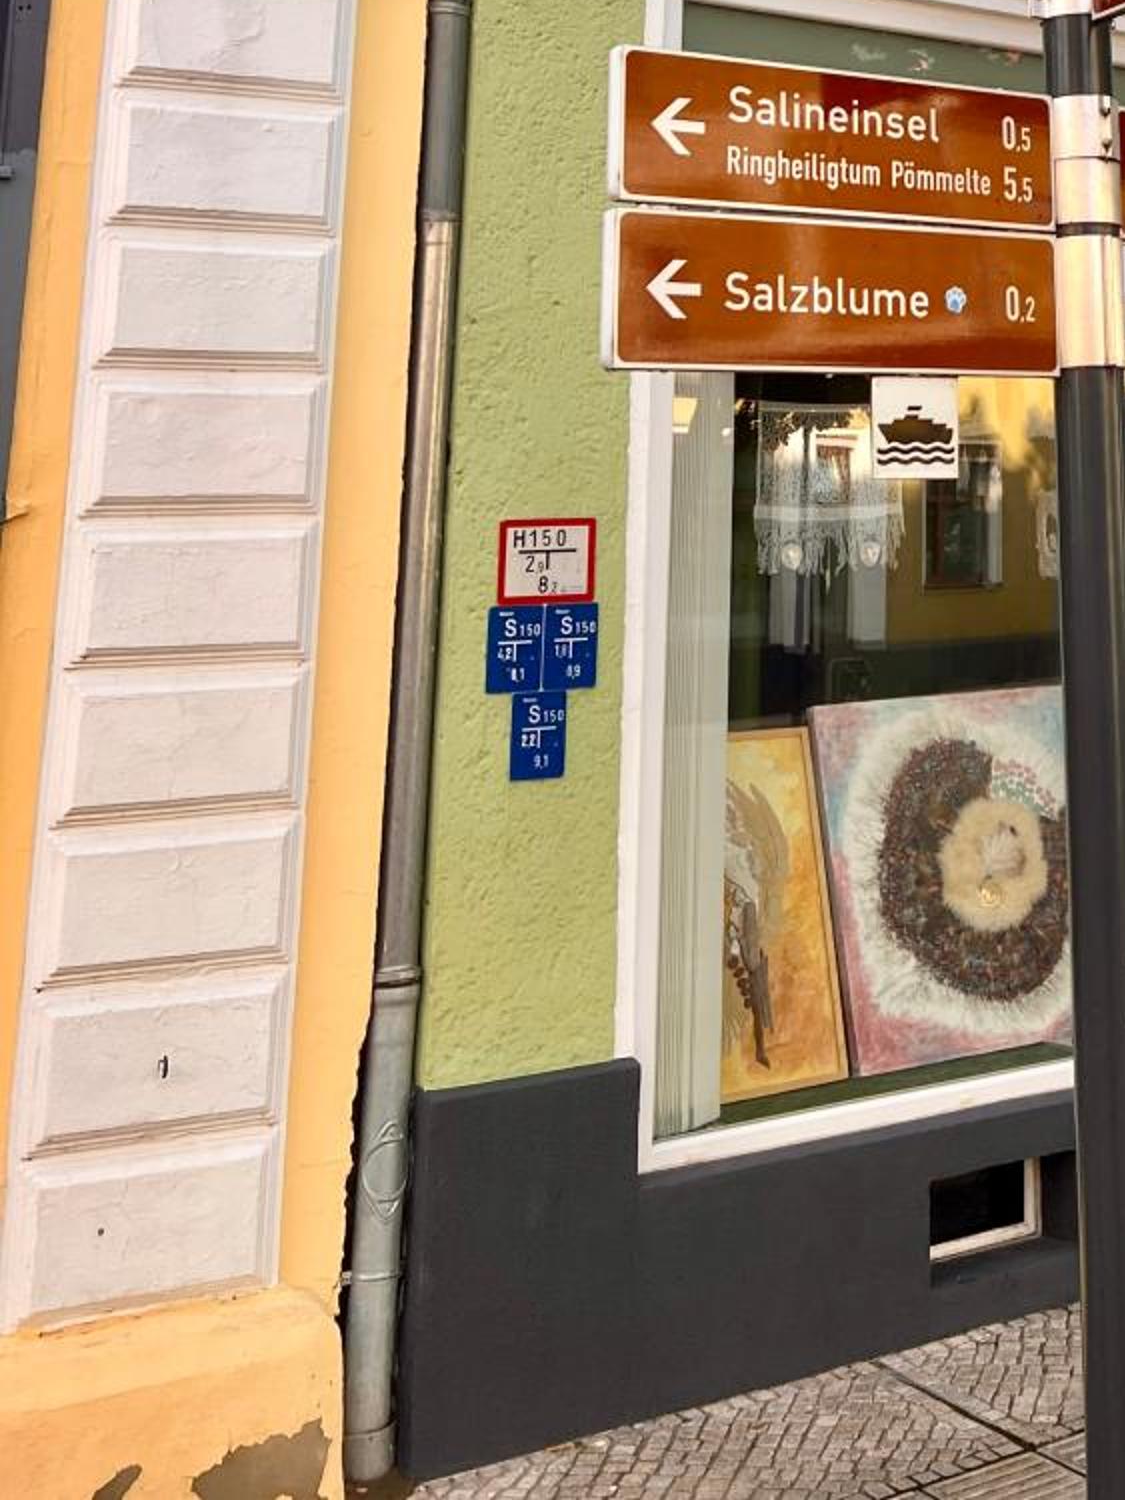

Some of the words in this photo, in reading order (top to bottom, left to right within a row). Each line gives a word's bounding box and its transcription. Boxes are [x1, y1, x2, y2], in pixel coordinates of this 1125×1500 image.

[727, 85, 940, 144] Salineinsel
[1001, 115, 1032, 153] 0.5
[726, 145, 881, 190] Ringheiligtum
[890, 160, 991, 196] Pömmelte
[1003, 166, 1033, 203] 5.5
[724, 271, 930, 318] Salzblume
[1004, 285, 1036, 323] 0.2
